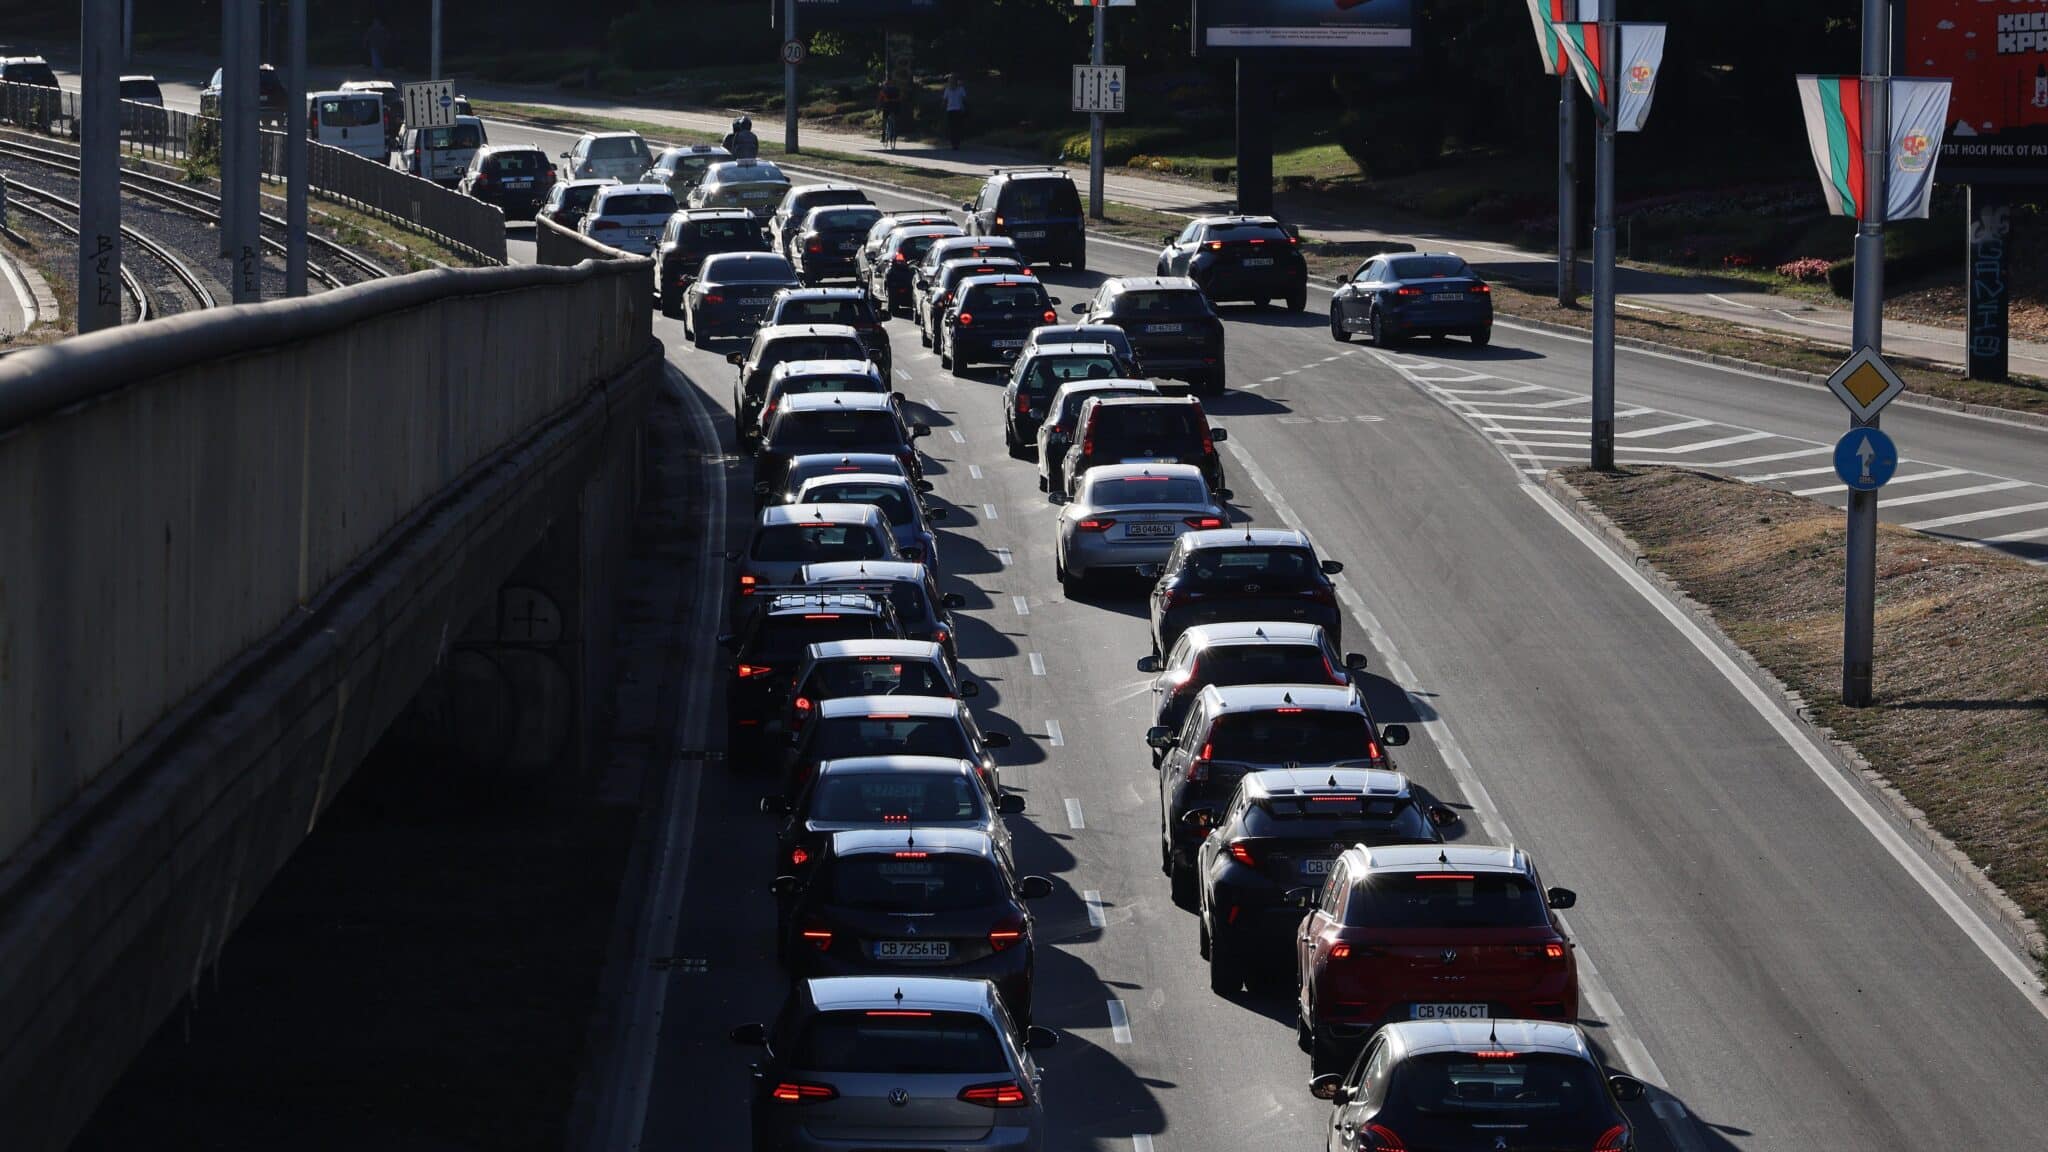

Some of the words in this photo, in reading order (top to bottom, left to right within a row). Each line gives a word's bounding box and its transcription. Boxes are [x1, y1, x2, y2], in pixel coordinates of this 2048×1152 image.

[787, 46, 801, 58] 70
[1962, 144, 1987, 155] НОСИ
[1991, 144, 2014, 156] РИСК
[2017, 145, 2029, 156] ОТ
[881, 943, 896, 956] CB
[899, 943, 928, 956] 7256
[931, 944, 947, 956] HB
[1418, 1006, 1434, 1018] CB
[1437, 1006, 1467, 1018] 9406
[1469, 1006, 1486, 1018] CT
